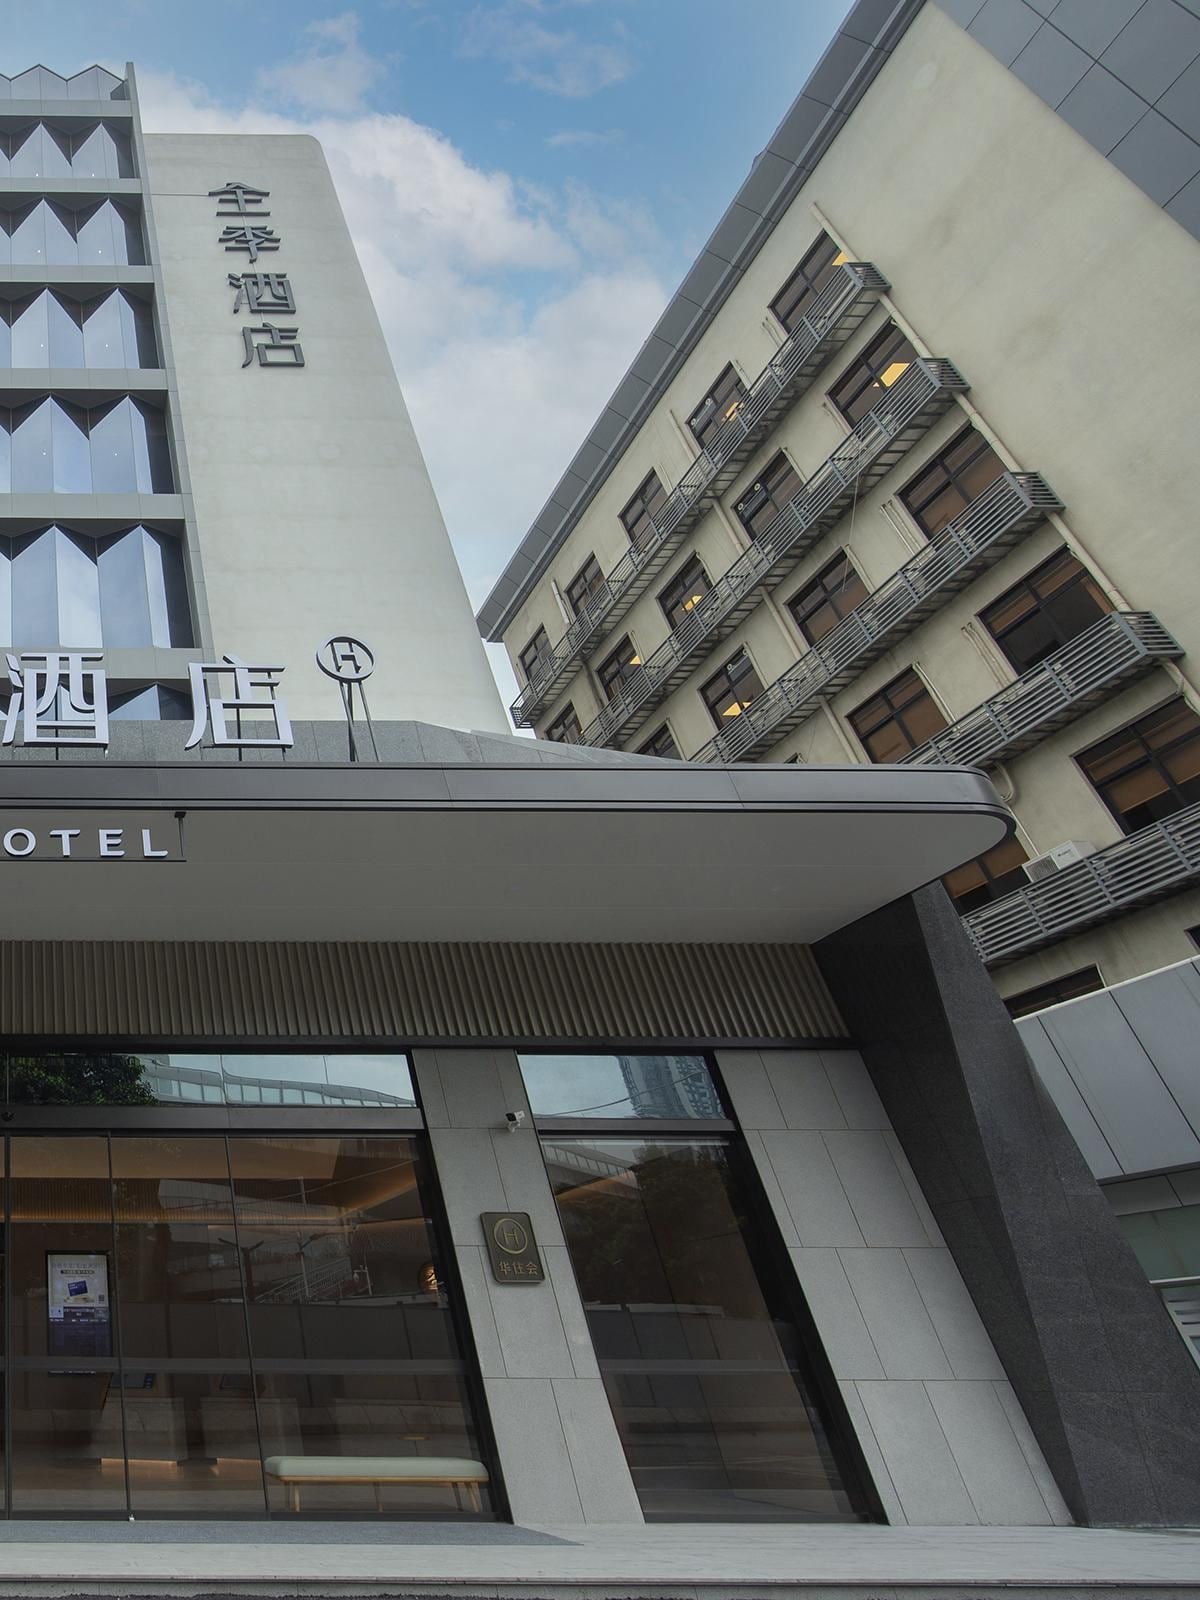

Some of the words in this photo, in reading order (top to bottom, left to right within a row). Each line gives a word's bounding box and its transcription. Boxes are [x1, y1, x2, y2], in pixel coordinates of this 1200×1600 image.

[207, 182, 305, 368] 全季酒店
[498, 1260, 538, 1276] 华住会
